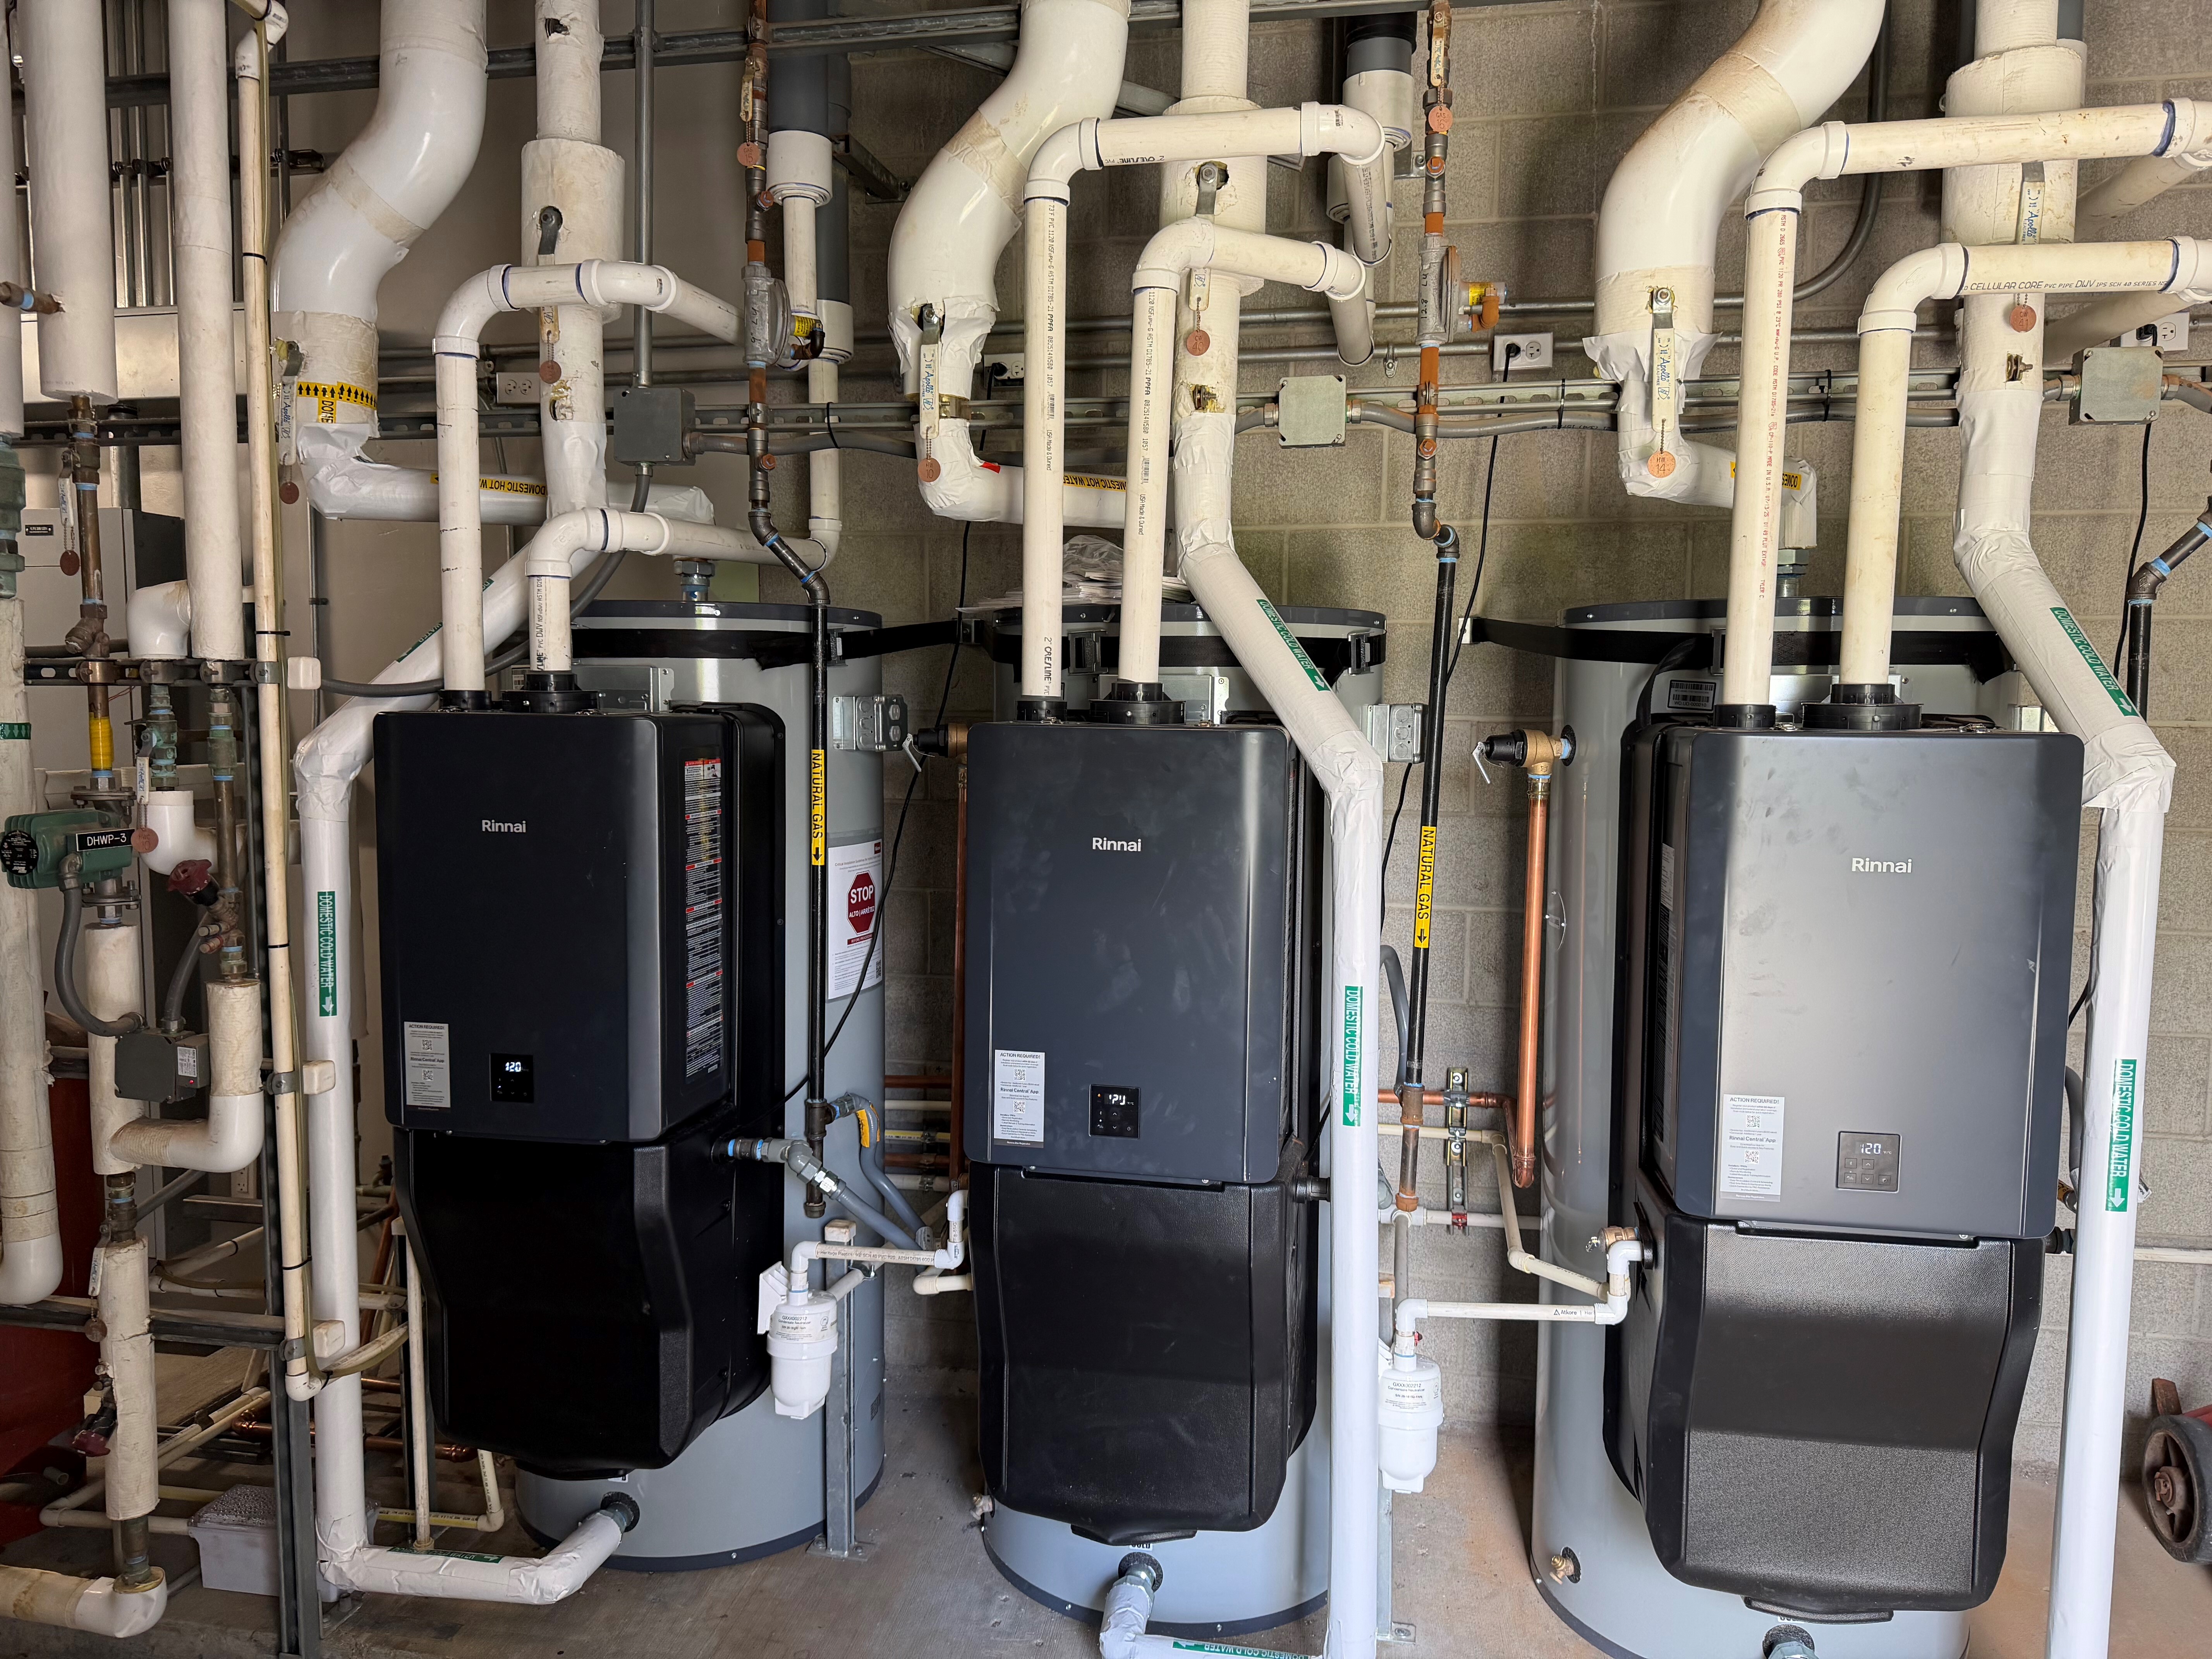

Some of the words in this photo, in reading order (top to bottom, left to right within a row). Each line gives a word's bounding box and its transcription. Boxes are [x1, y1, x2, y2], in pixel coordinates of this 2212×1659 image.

[1437, 119, 1444, 129] 16
[745, 154, 753, 163] 15
[1970, 282, 2016, 291] CELLULAR
[2018, 281, 2043, 290] CORE
[2075, 280, 2095, 289] DWV
[1192, 342, 1204, 352] 40
[926, 469, 934, 479] 10
[1655, 464, 1666, 474] 14
[489, 481, 505, 490] HOT
[507, 483, 546, 495] DOMESTIC
[1086, 477, 1100, 487] HOT
[536, 623, 544, 637] DWV
[1259, 602, 1289, 630] DOMESTIC
[1280, 631, 1298, 647] COLD
[1292, 648, 1312, 669] WATER
[2053, 610, 2088, 644] DOMESTIC
[2079, 644, 2099, 664] COLD
[2093, 665, 2119, 690] WATER
[812, 753, 823, 809] NATURAL
[481, 819, 527, 833] Rinnai
[812, 814, 823, 839] GAS
[87, 833, 127, 846] DHWP-3
[1092, 837, 1142, 853] Rinnai
[1420, 830, 1434, 889] NATURAL
[1851, 857, 1913, 874] Rinnai
[850, 887, 874, 904] STOP
[319, 895, 333, 935] DOMESTIC
[849, 910, 859, 918] ALTO
[1418, 894, 1430, 920] GAS
[320, 937, 334, 959] COLD
[320, 960, 334, 988] WATER
[1346, 990, 1358, 1034] DOMESTIC
[1345, 1036, 1358, 1061] COLD
[1345, 1062, 1357, 1094] WATER
[2115, 1063, 2134, 1111] DOMESTIC
[2113, 1112, 2132, 1142] COLD
[1861, 1143, 1882, 1154] 120
[2110, 1144, 2129, 1177] WATER
[1204, 1644, 1235, 1653] WATER
[1236, 1648, 1261, 1657] COLD
